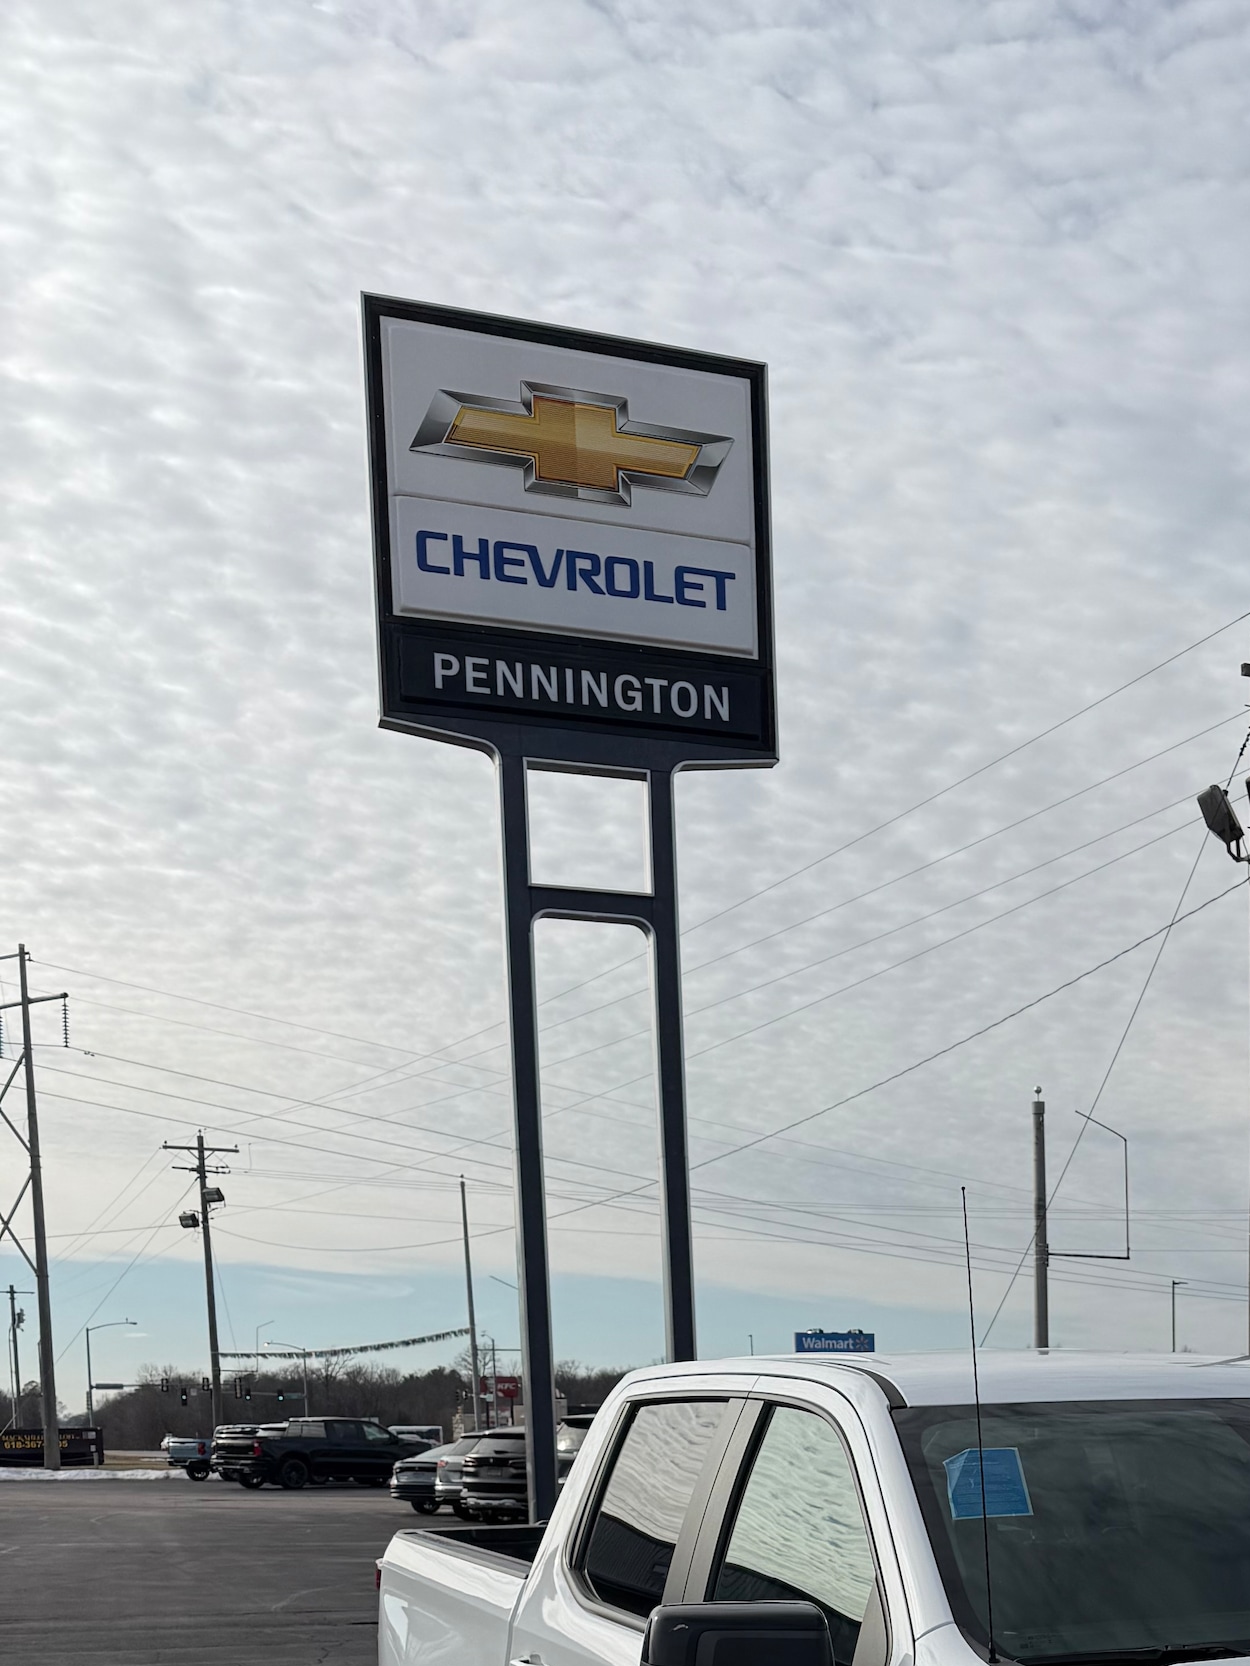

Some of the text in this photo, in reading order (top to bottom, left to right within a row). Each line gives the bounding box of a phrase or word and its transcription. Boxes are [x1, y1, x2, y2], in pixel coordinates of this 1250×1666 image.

[416, 530, 736, 610] CHEVROLET
[433, 652, 730, 721] PENNINGTON
[802, 1337, 854, 1350] Walmart
[497, 1382, 516, 1390] KFC
